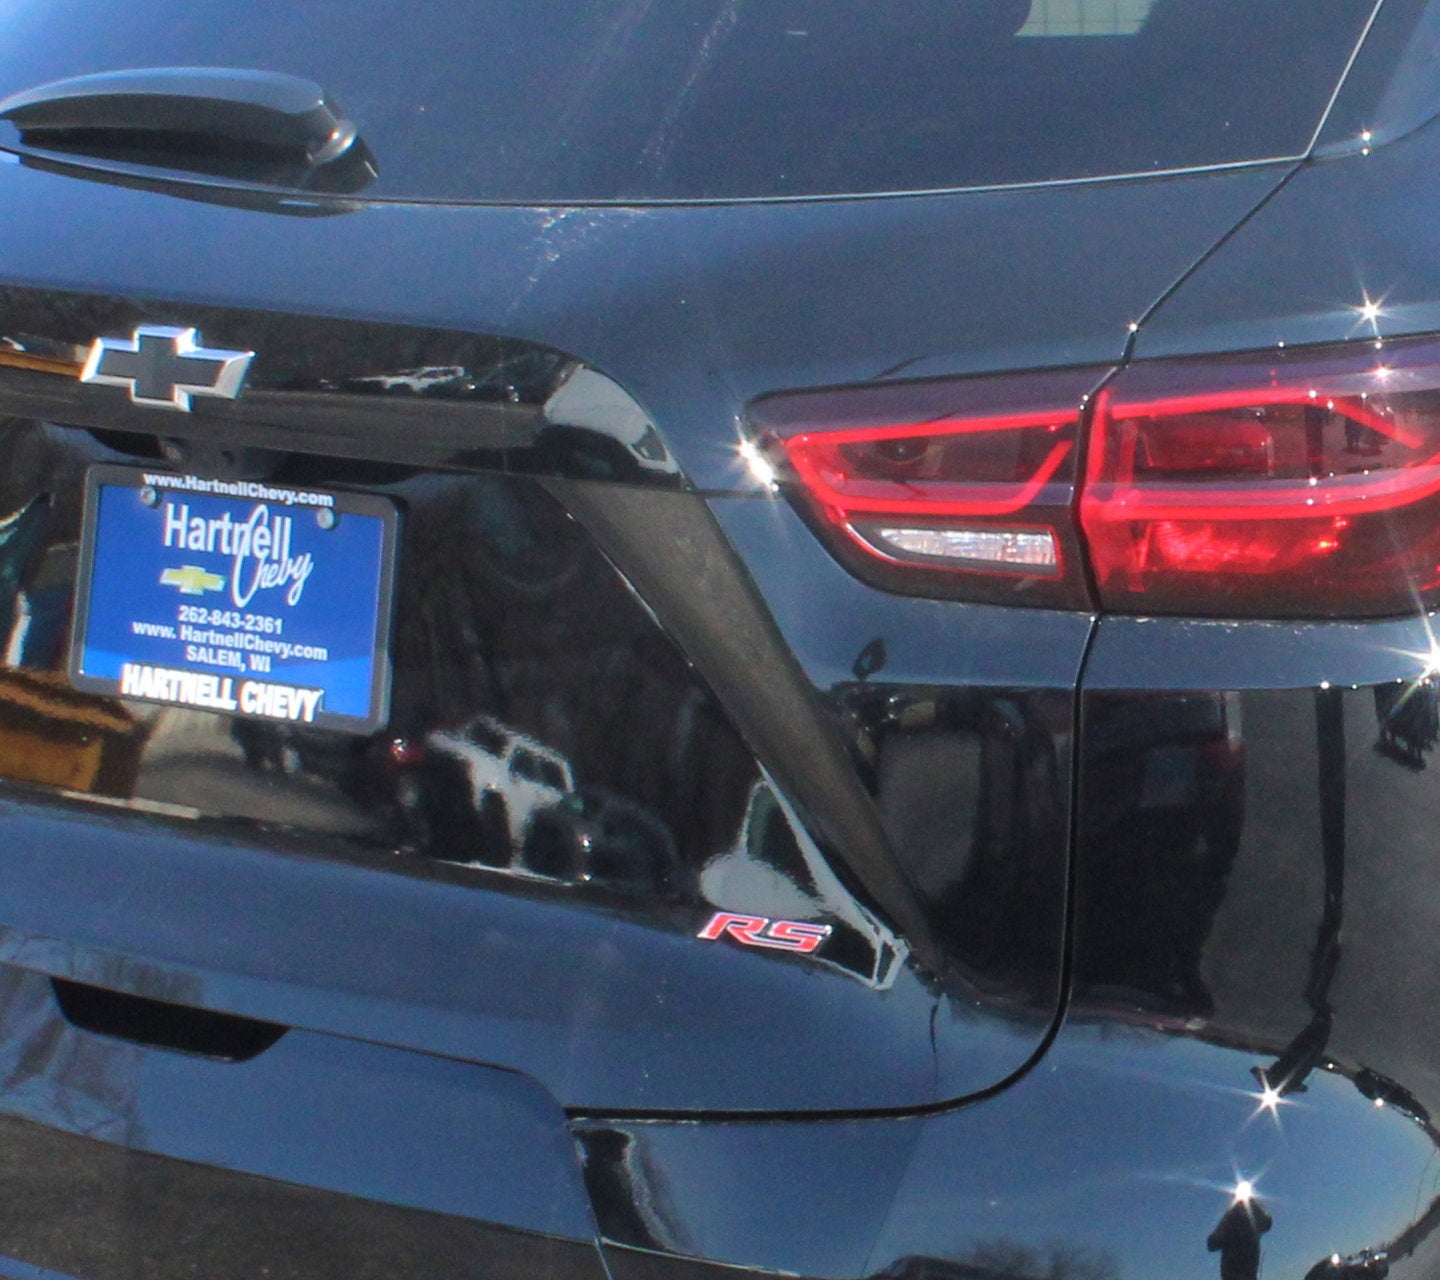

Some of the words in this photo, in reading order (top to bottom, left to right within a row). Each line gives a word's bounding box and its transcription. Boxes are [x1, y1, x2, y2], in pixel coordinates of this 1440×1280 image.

[142, 473, 334, 507] www.HartnellChevy.com
[164, 502, 293, 562] Hartnell
[232, 503, 314, 608] Chevy
[177, 605, 283, 635] 262-843-2361
[132, 621, 176, 639] www.
[179, 625, 328, 661] HartnellChevy.com
[186, 645, 246, 672] SALEM,
[250, 653, 271, 673] WI
[121, 663, 238, 711] HARTNELL
[239, 679, 323, 723] CHEVY
[696, 911, 833, 953] RS
